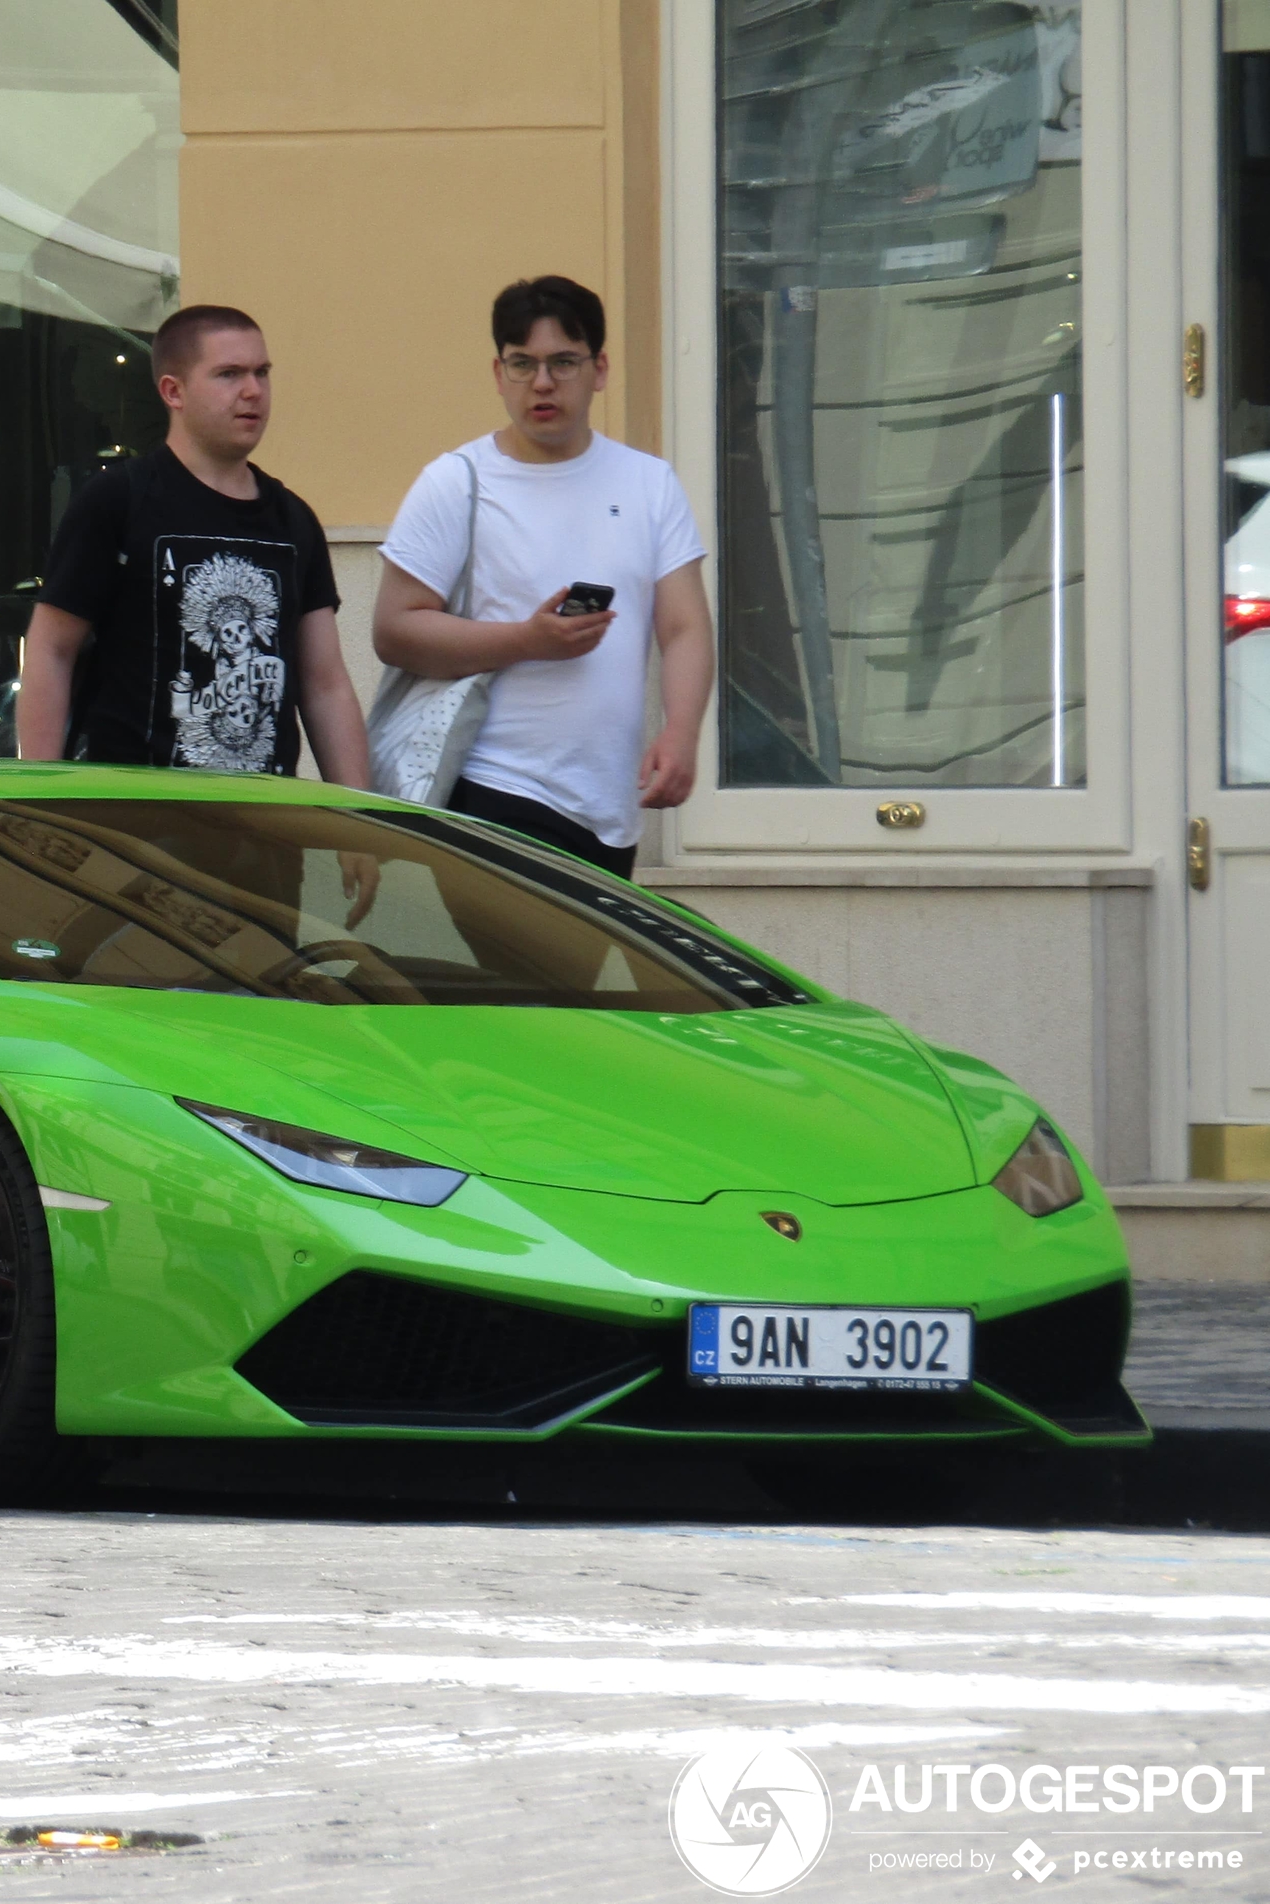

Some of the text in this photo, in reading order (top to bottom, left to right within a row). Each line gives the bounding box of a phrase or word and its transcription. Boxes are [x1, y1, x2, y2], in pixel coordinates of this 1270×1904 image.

[161, 547, 177, 571] A
[730, 1314, 950, 1372] 9AN 3902
[694, 1350, 716, 1366] CZ
[719, 1376, 749, 1386] STERN
[750, 1376, 805, 1387] AUTOMOBILE
